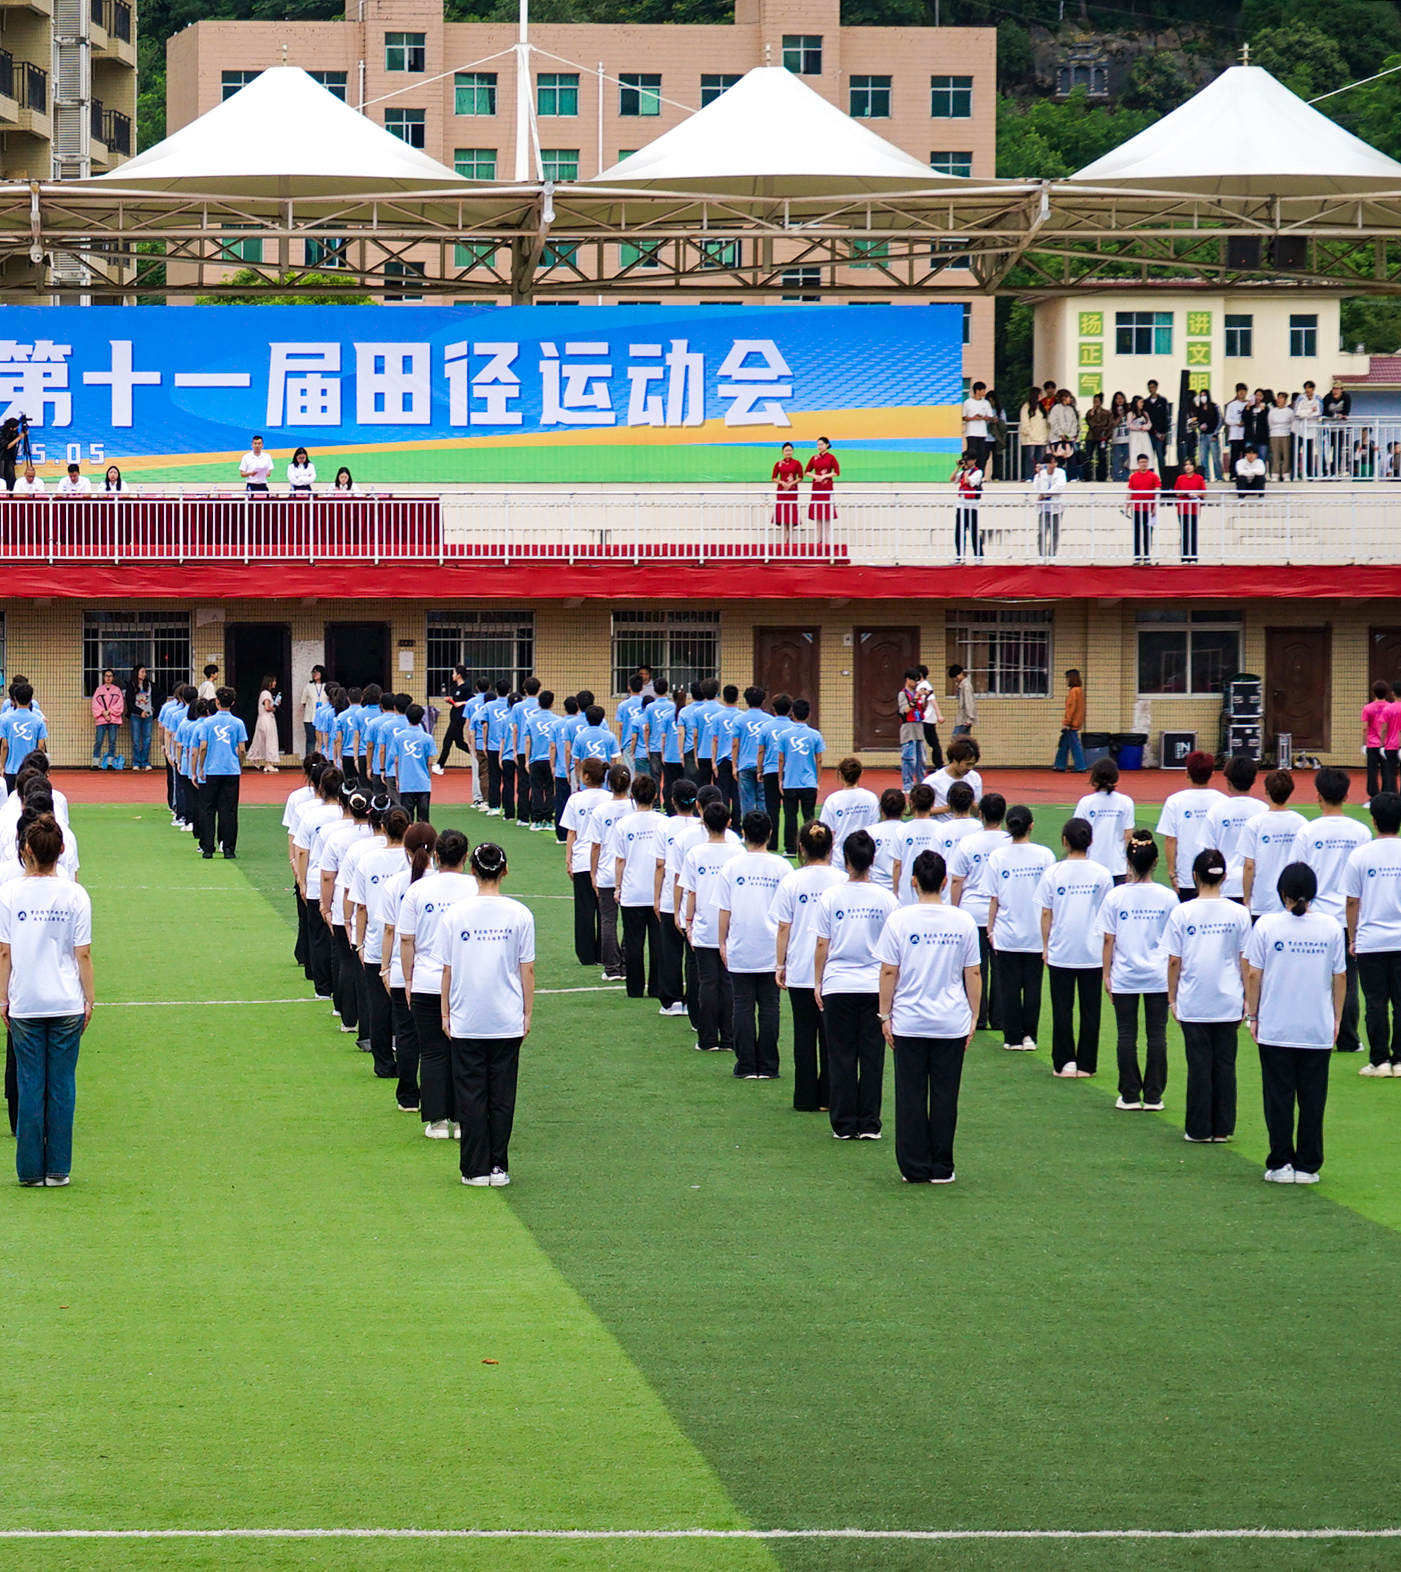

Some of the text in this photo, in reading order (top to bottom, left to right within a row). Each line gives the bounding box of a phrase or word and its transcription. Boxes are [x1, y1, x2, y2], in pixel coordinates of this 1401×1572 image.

[1080, 314, 1102, 395] 扬正气
[1188, 314, 1210, 394] 讲文明
